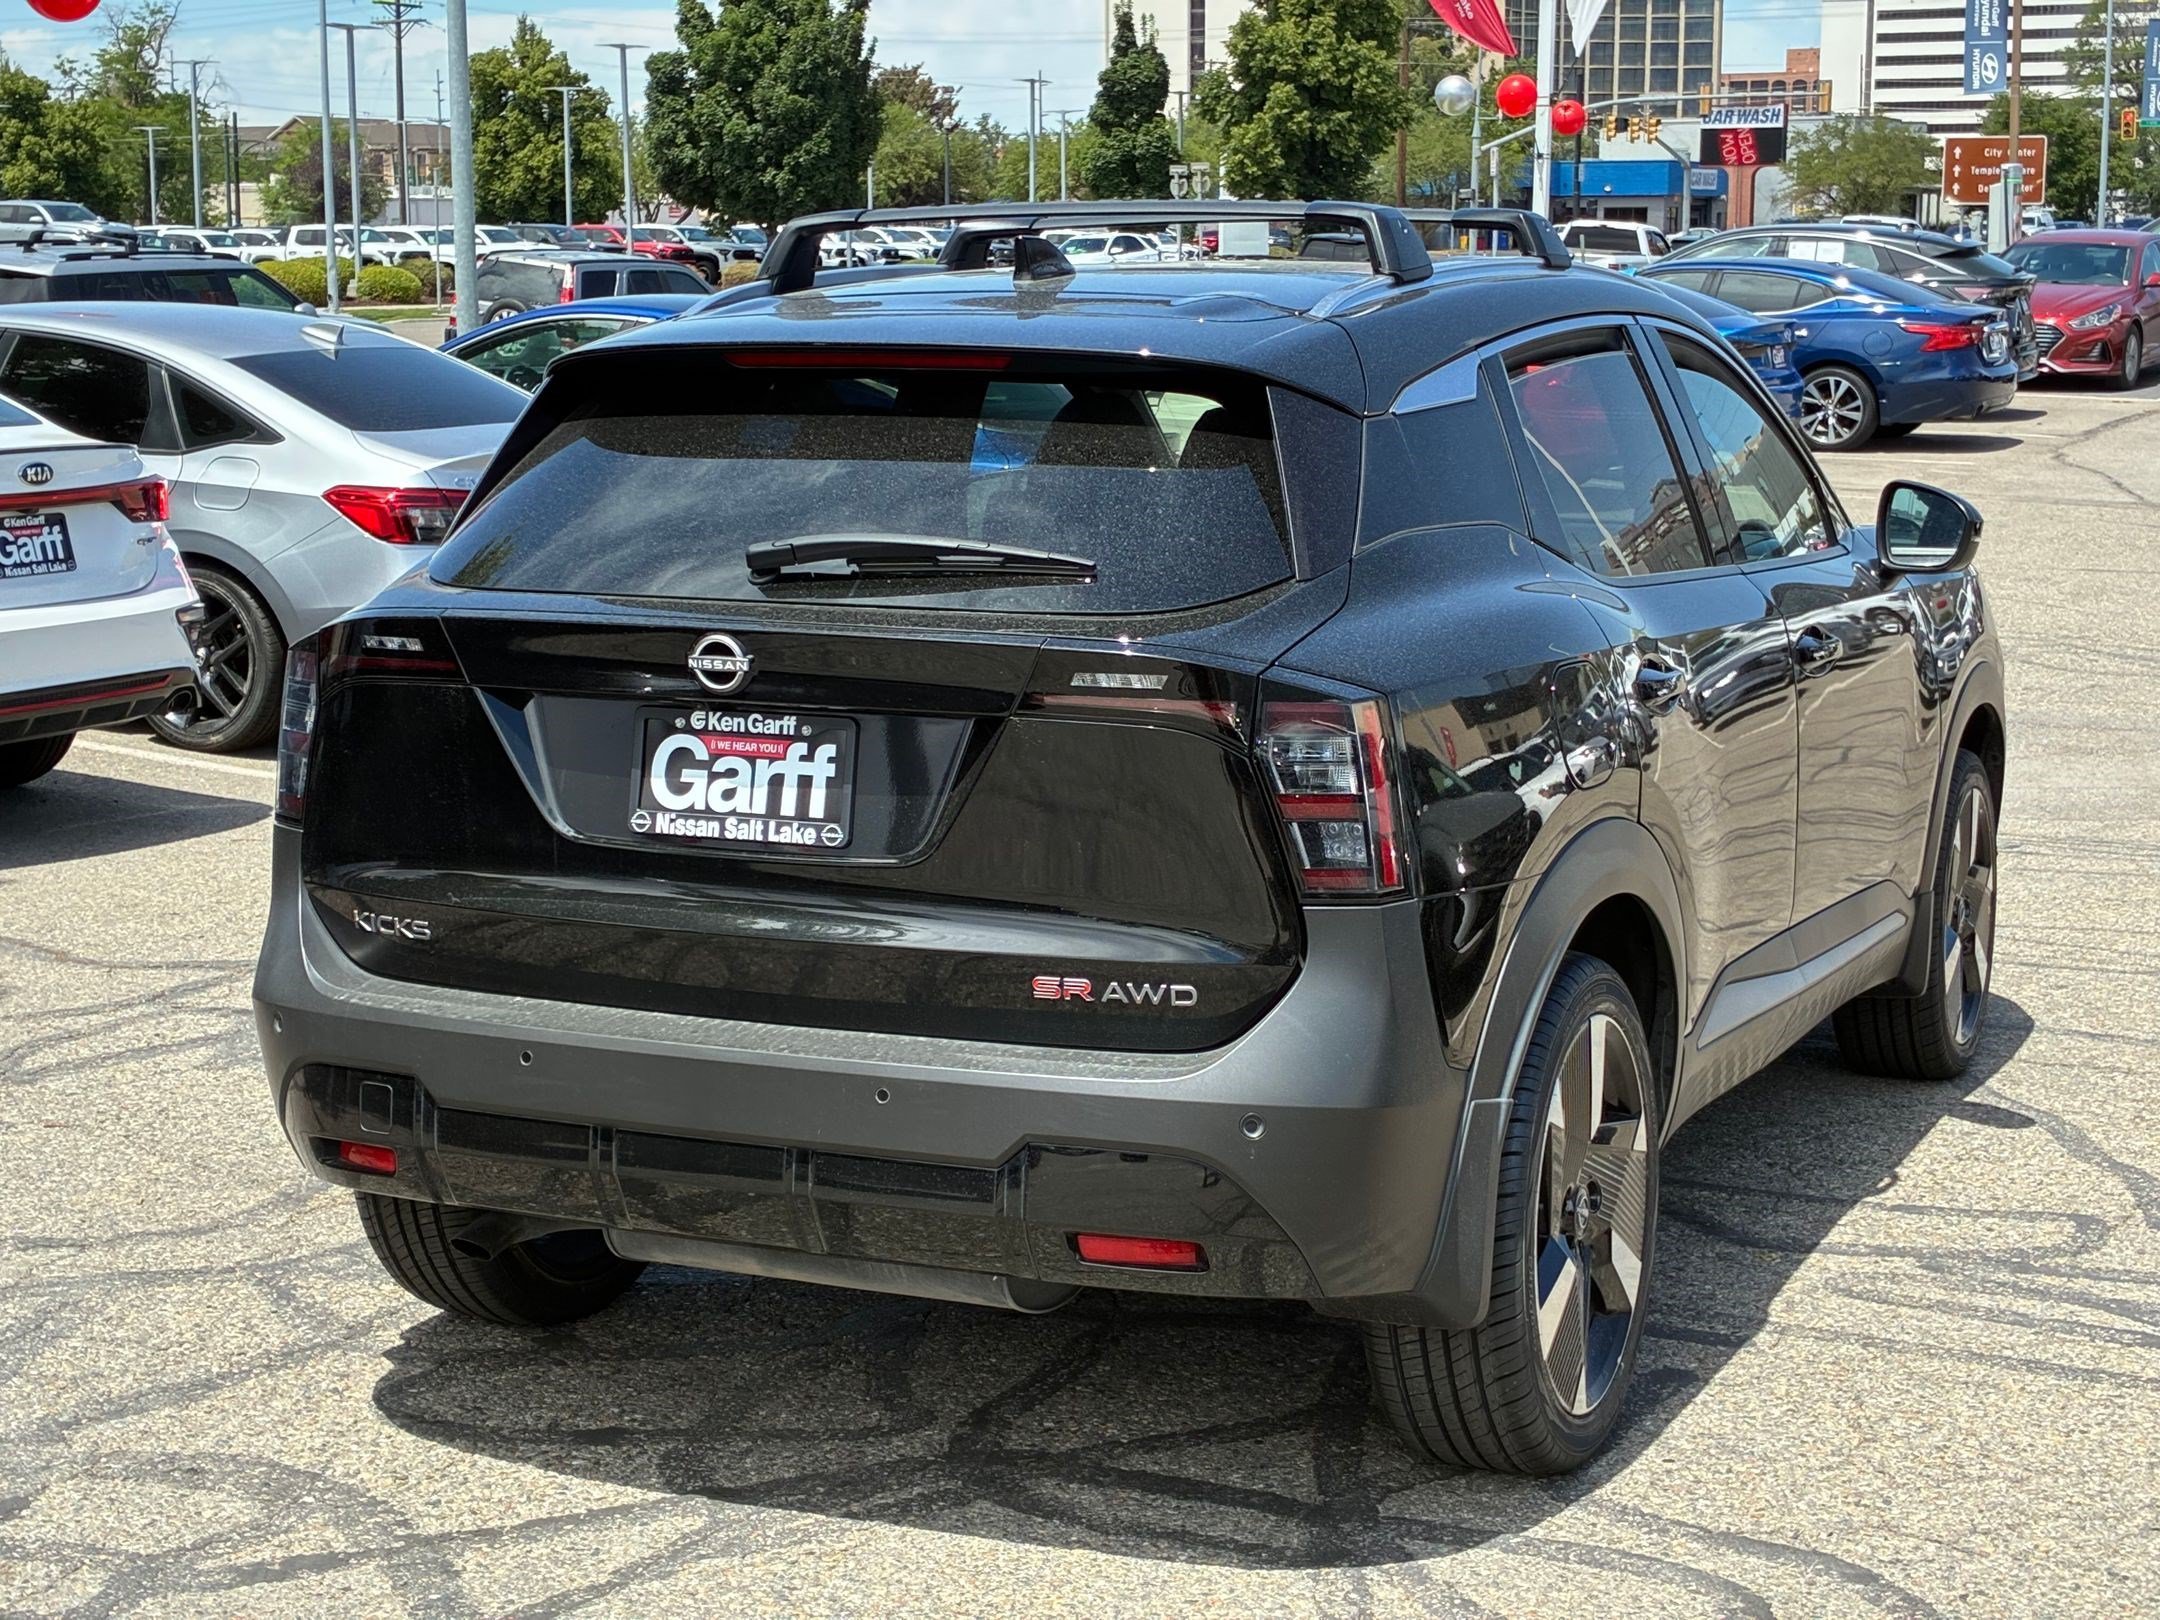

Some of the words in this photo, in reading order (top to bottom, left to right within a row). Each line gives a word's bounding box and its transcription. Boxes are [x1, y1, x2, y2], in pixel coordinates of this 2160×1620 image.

[1991, 7, 2000, 27] Garff
[1972, 48, 1980, 90] HYUNDAI
[2149, 83, 2157, 118] HYUNDAI
[1736, 108, 1781, 124] WASH
[1720, 134, 1738, 165] NOW
[1737, 128, 1756, 164] OPEN
[1984, 148, 2003, 158] City
[2008, 148, 2036, 157] nter
[1971, 166, 2000, 177] Temple
[26, 466, 51, 482] KIA
[11, 517, 26, 527] Ken
[26, 514, 45, 526] Garff
[0, 525, 64, 566] Garff
[5, 566, 32, 577] Nissan
[32, 563, 48, 574] Salt
[48, 561, 67, 572] Lake
[688, 657, 749, 671] NISSAN
[708, 711, 745, 734] Ken
[748, 713, 797, 736] Garff
[717, 741, 731, 750] WE
[733, 741, 757, 752] HEAR
[759, 743, 778, 753] YOU
[650, 733, 837, 819] Garff
[655, 812, 720, 838] Nissan
[724, 816, 763, 842] Salt
[768, 821, 817, 846] Lake
[353, 909, 432, 940] KICKS
[1032, 975, 1096, 1002] SR
[1100, 981, 1198, 1007] AWD
